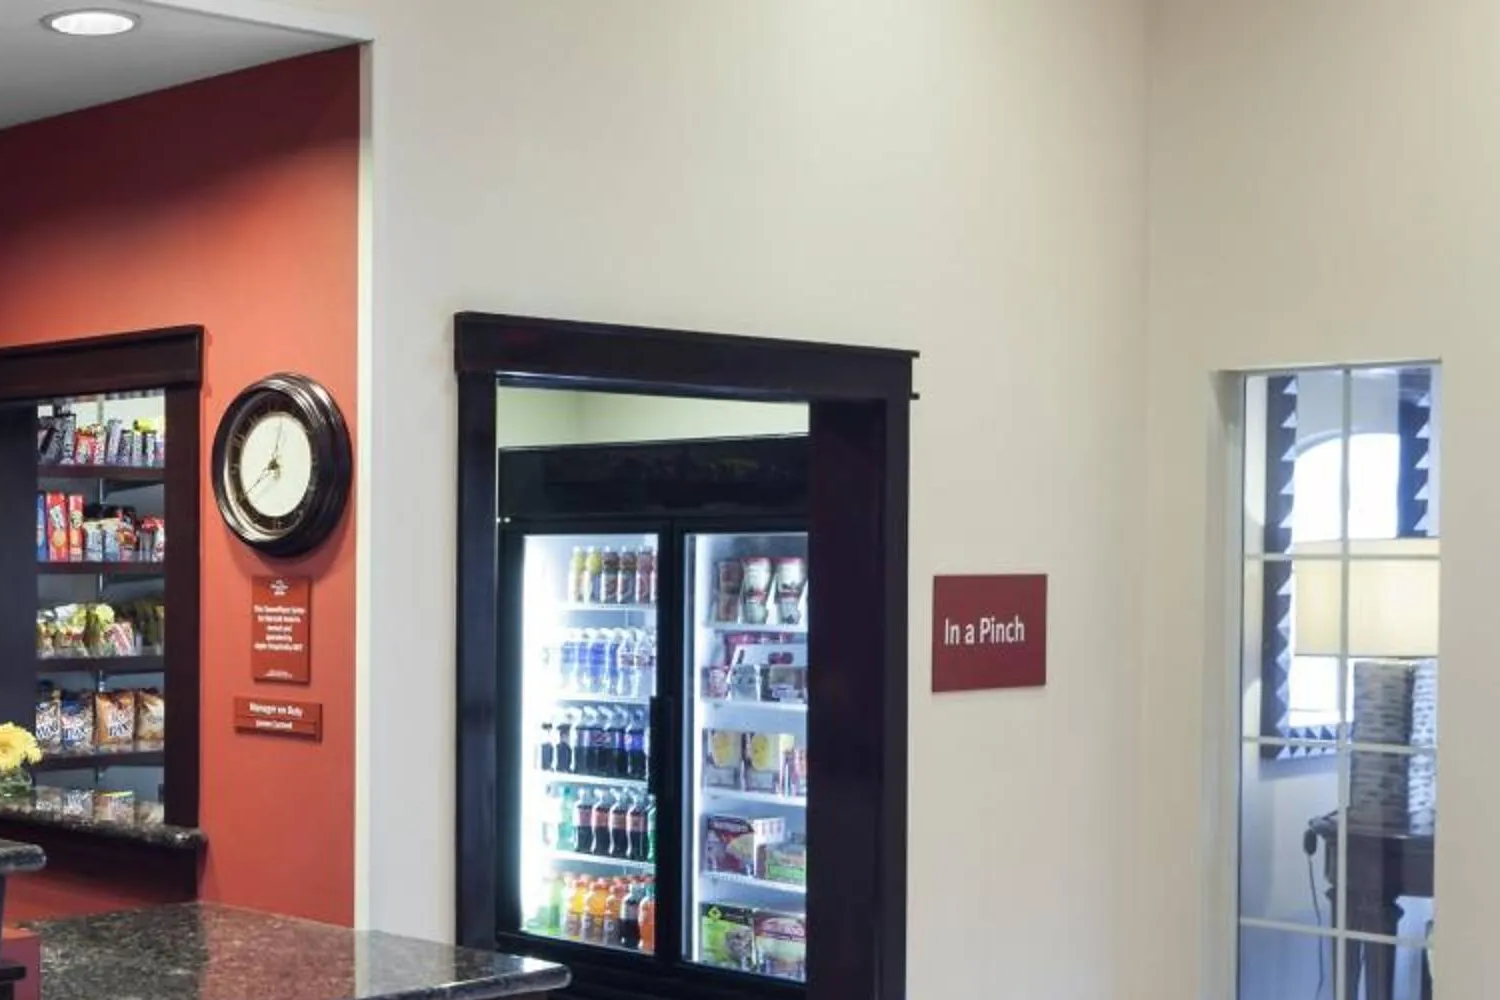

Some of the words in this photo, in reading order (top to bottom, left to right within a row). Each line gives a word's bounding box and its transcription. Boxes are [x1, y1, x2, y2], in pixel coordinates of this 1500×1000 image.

[944, 617, 960, 645] In
[965, 623, 975, 645] a
[979, 615, 1025, 644] Pinch
